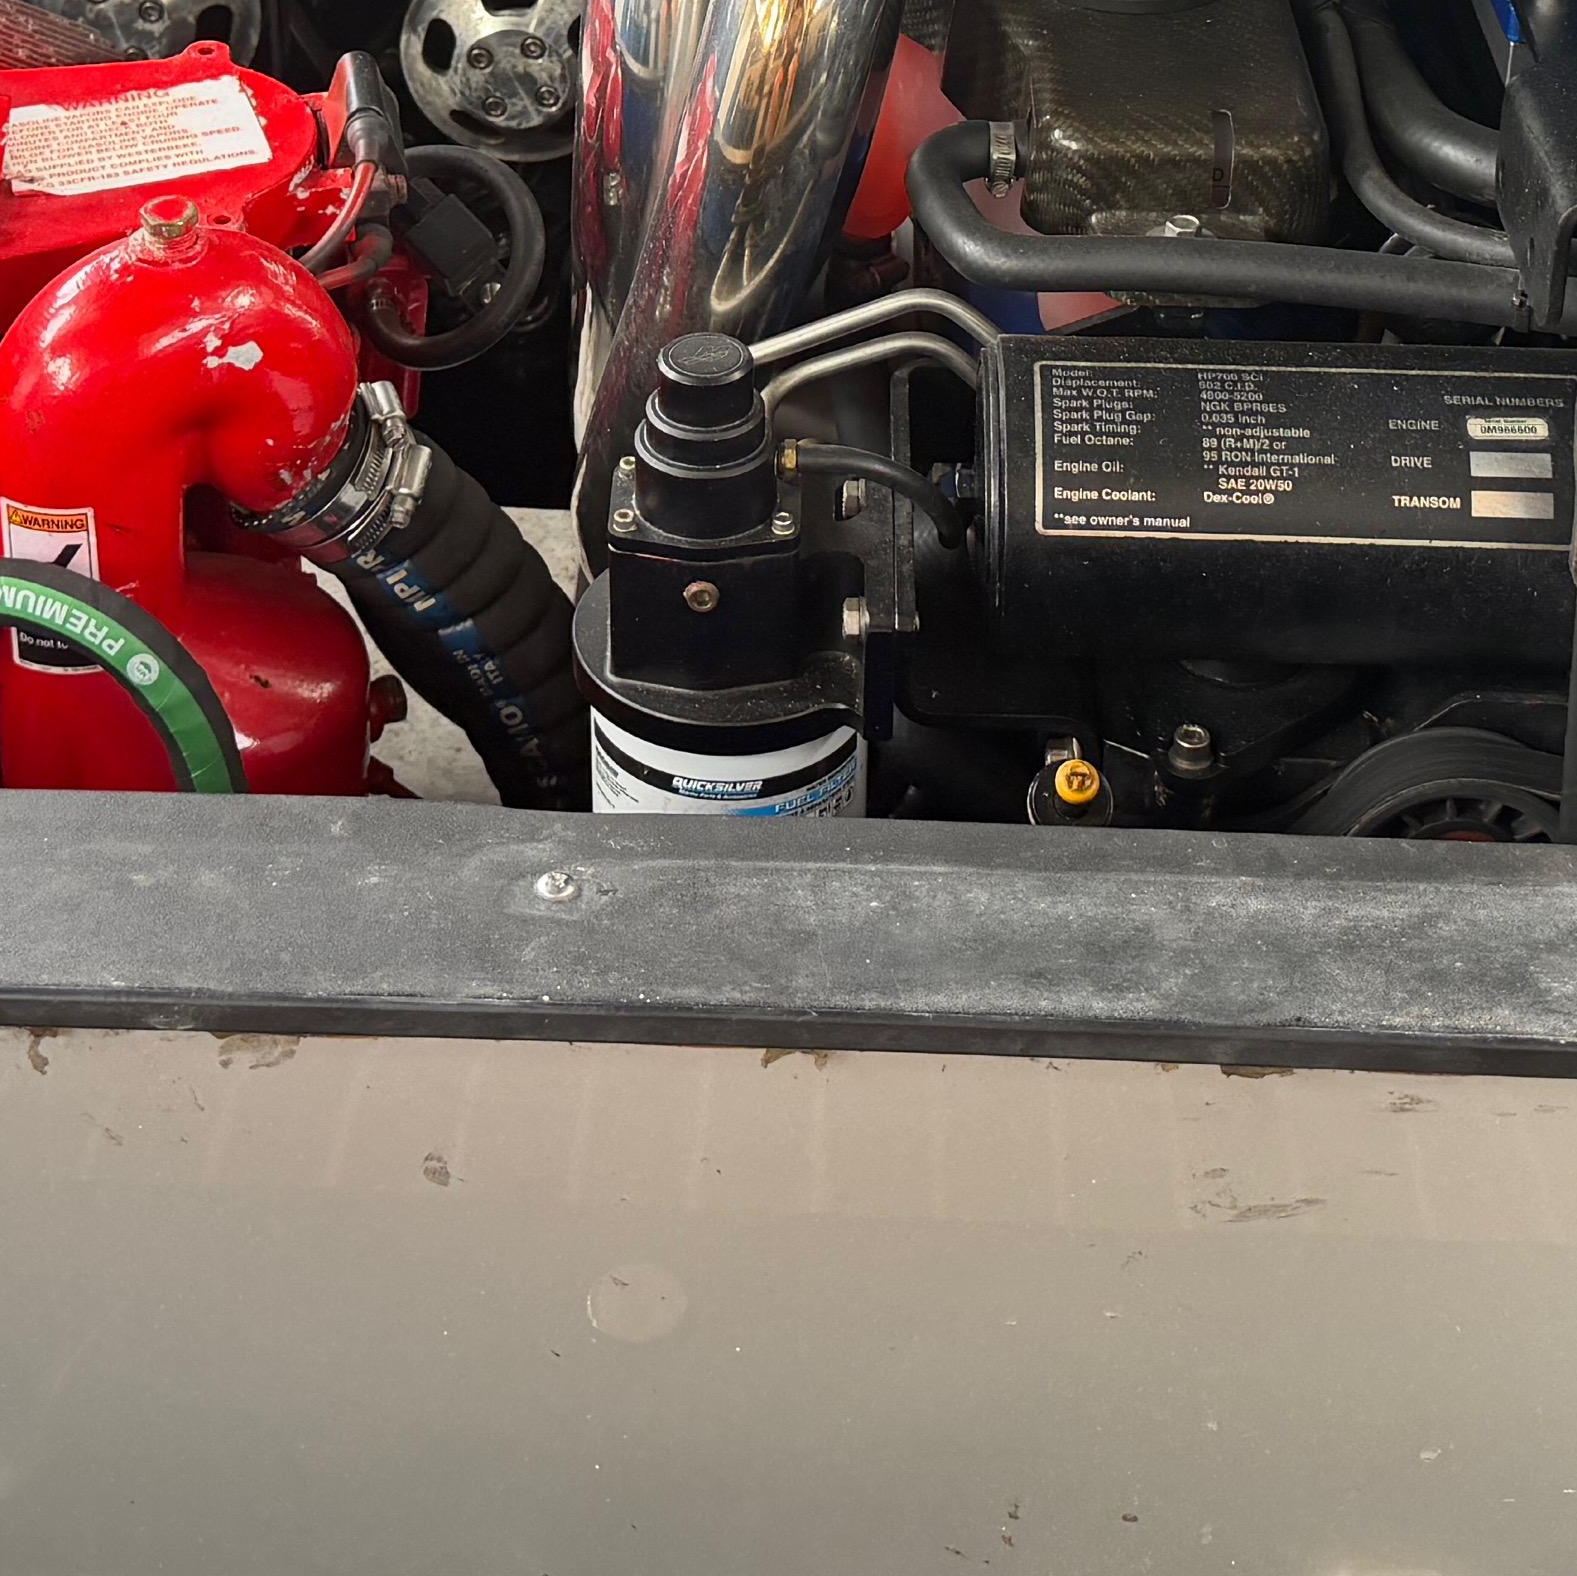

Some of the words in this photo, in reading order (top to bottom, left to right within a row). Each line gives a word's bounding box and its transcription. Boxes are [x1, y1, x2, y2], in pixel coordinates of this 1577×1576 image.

[1052, 387, 1078, 396] Max
[1125, 389, 1159, 399] RPM:
[1053, 398, 1089, 408] Spark
[1093, 399, 1133, 410] Plugs:
[1201, 401, 1230, 412] NGK
[1443, 395, 1494, 407] SERIAL
[1496, 396, 1565, 408] NUMBERS
[1053, 409, 1090, 420] Spark
[1093, 410, 1122, 422] Plug
[1125, 411, 1156, 423] Gap:
[1201, 413, 1235, 423] 0.035
[1053, 421, 1090, 432] Spark
[1095, 422, 1141, 435] Timing:
[1388, 419, 1440, 431] ENGINE
[1216, 426, 1311, 438] non-adjustable
[1054, 433, 1081, 444] Fuel
[1085, 434, 1134, 446] Octane:
[1202, 437, 1218, 448] 89
[1221, 437, 1270, 451] (R+M)/2
[1273, 441, 1287, 450] or
[1202, 451, 1218, 462] 95
[1221, 451, 1252, 462] RON
[1391, 455, 1433, 468] DRIVE
[1054, 460, 1099, 474] Engine
[1102, 461, 1124, 473] Oil:
[1218, 464, 1266, 477] Kendall
[1270, 466, 1300, 477] GT-1
[1218, 478, 1246, 490] SAE
[1249, 479, 1293, 492] 20W50
[1054, 487, 1099, 502] Engine
[1102, 488, 1156, 502] Coolant:
[1392, 495, 1462, 510] TRANSOM
[21, 513, 86, 531] WARNING
[1090, 515, 1140, 526] owner's
[1143, 516, 1191, 528] manual
[19, 630, 34, 644] Do
[36, 637, 55, 649] not
[672, 776, 763, 792] QUICKSILVER
[775, 793, 815, 814] FUEL
